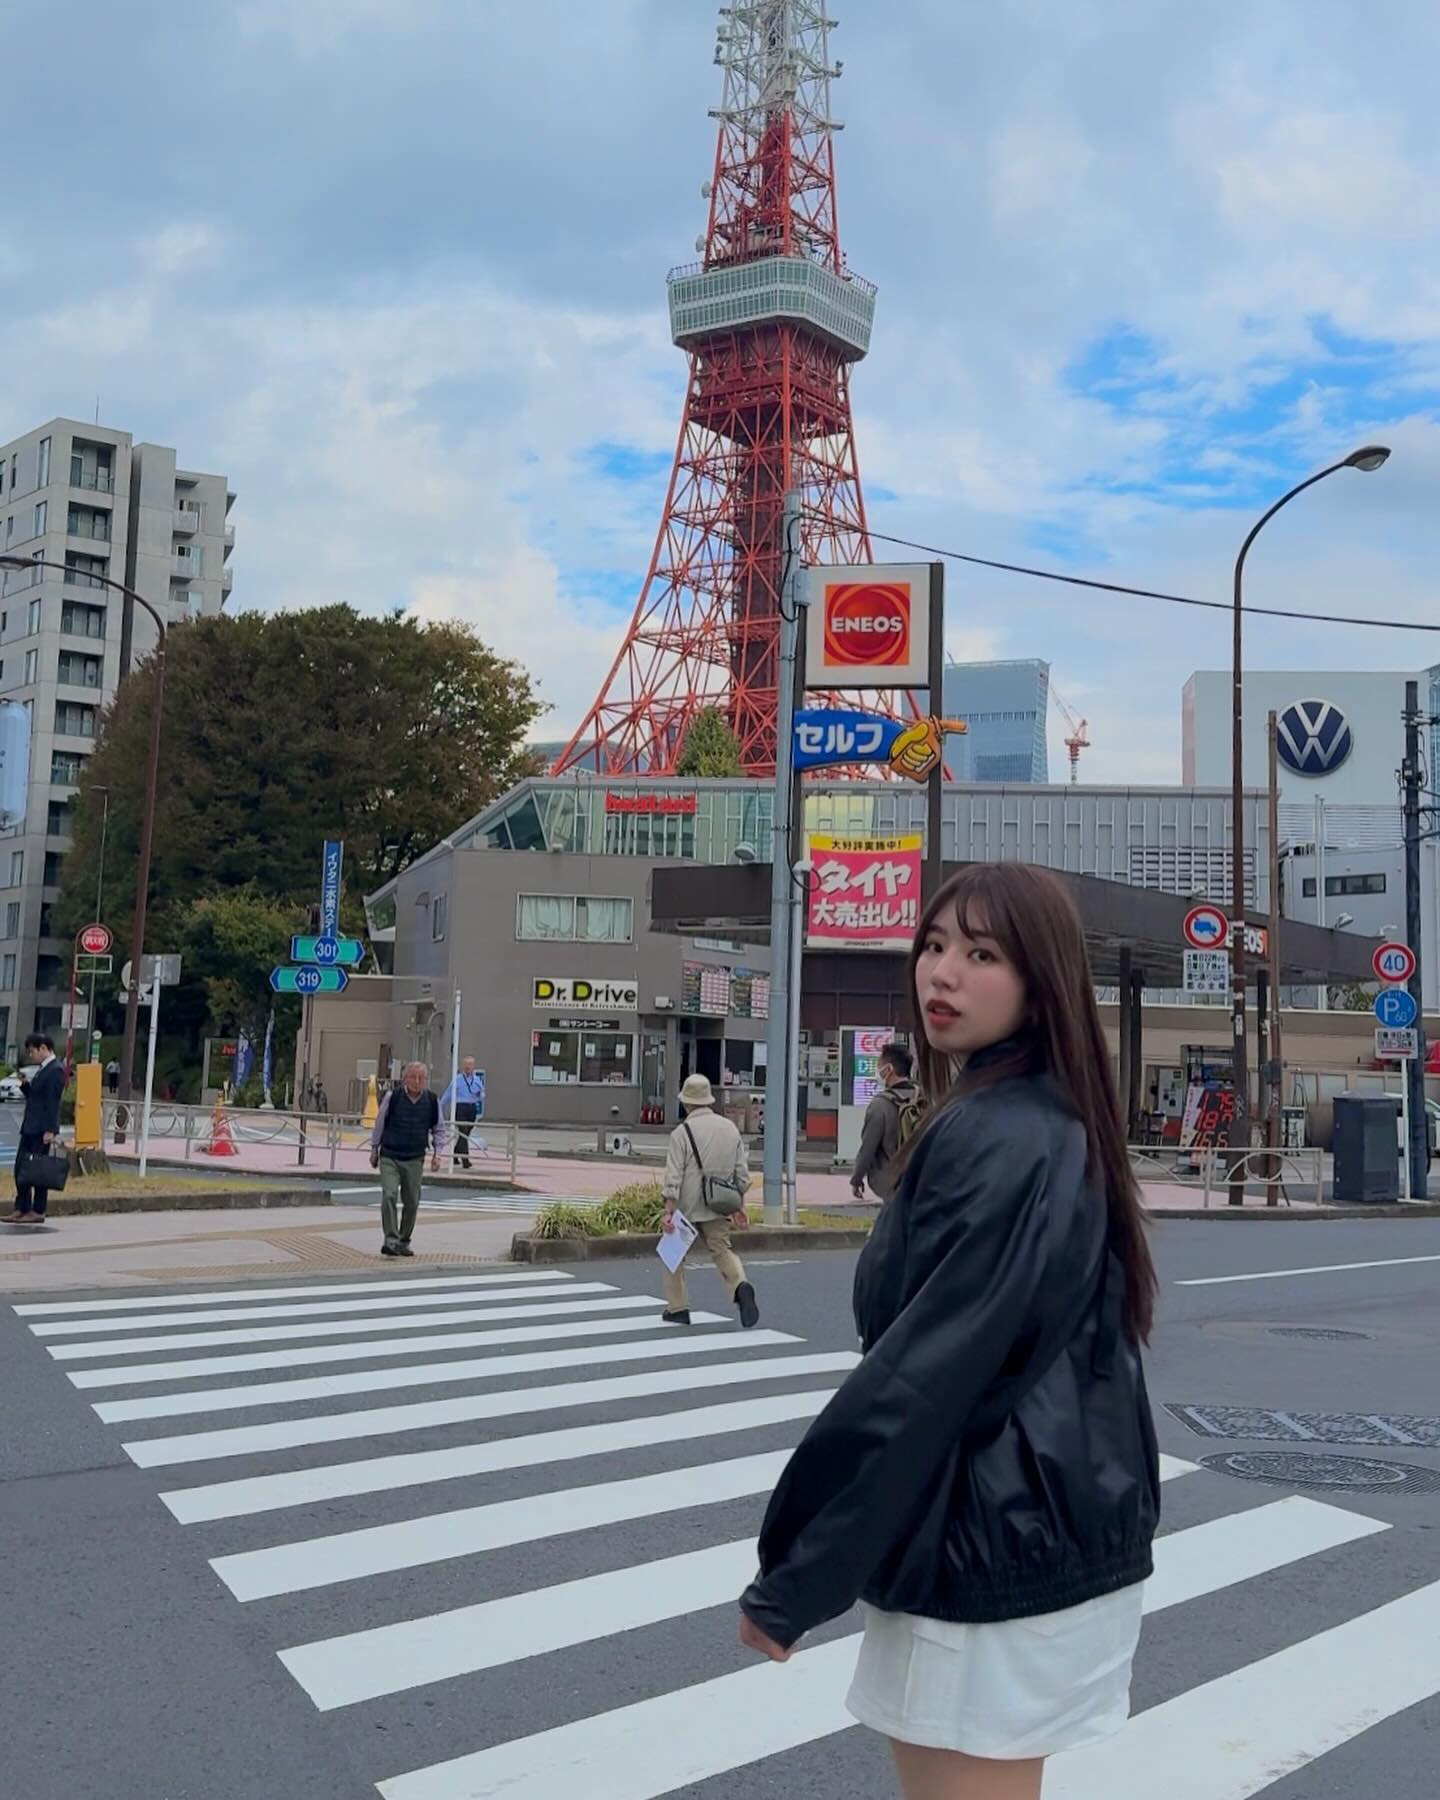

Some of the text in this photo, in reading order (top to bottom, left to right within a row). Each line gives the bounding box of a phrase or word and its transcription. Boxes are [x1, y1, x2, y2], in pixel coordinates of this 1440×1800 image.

[831, 616, 903, 633] ENEOS
[795, 722, 884, 754] セルフ
[818, 860, 912, 897] タイヤ
[812, 898, 917, 928] 大売出し!!
[316, 944, 337, 957] 301
[1383, 954, 1405, 972] 40
[298, 972, 319, 987] 319
[1383, 998, 1400, 1022] P
